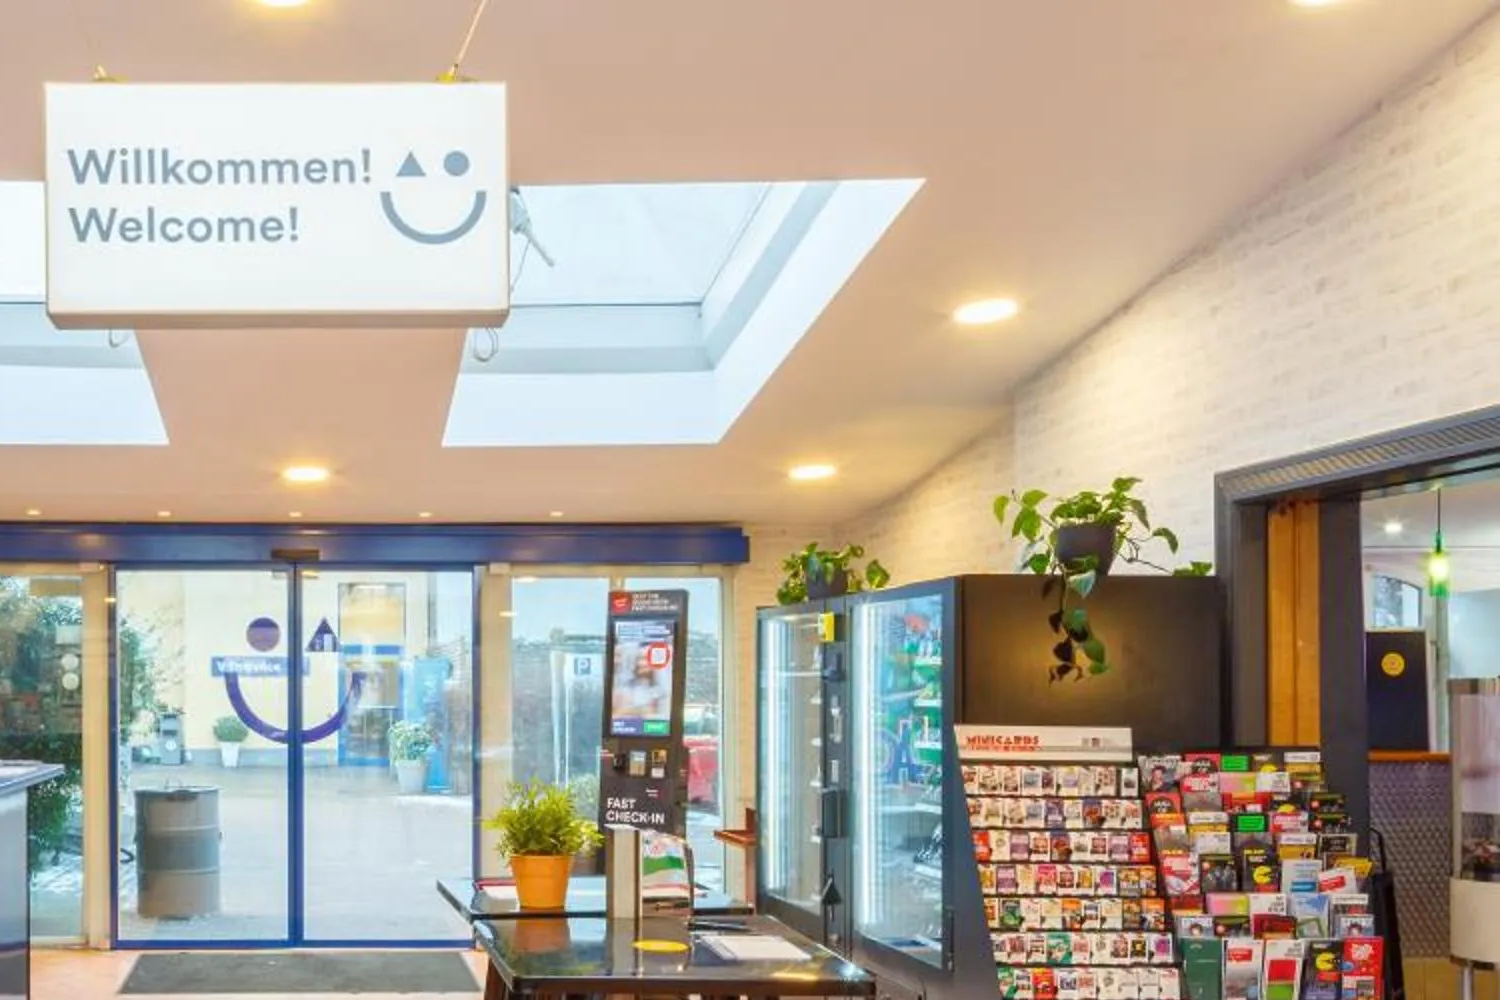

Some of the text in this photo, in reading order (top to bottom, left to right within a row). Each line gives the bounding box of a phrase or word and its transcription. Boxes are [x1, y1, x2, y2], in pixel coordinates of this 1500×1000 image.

[67, 148, 372, 185] Willkommen!
[68, 207, 300, 242] Welcome!
[606, 797, 636, 810] FAST
[605, 810, 665, 825] CHECK-IN
